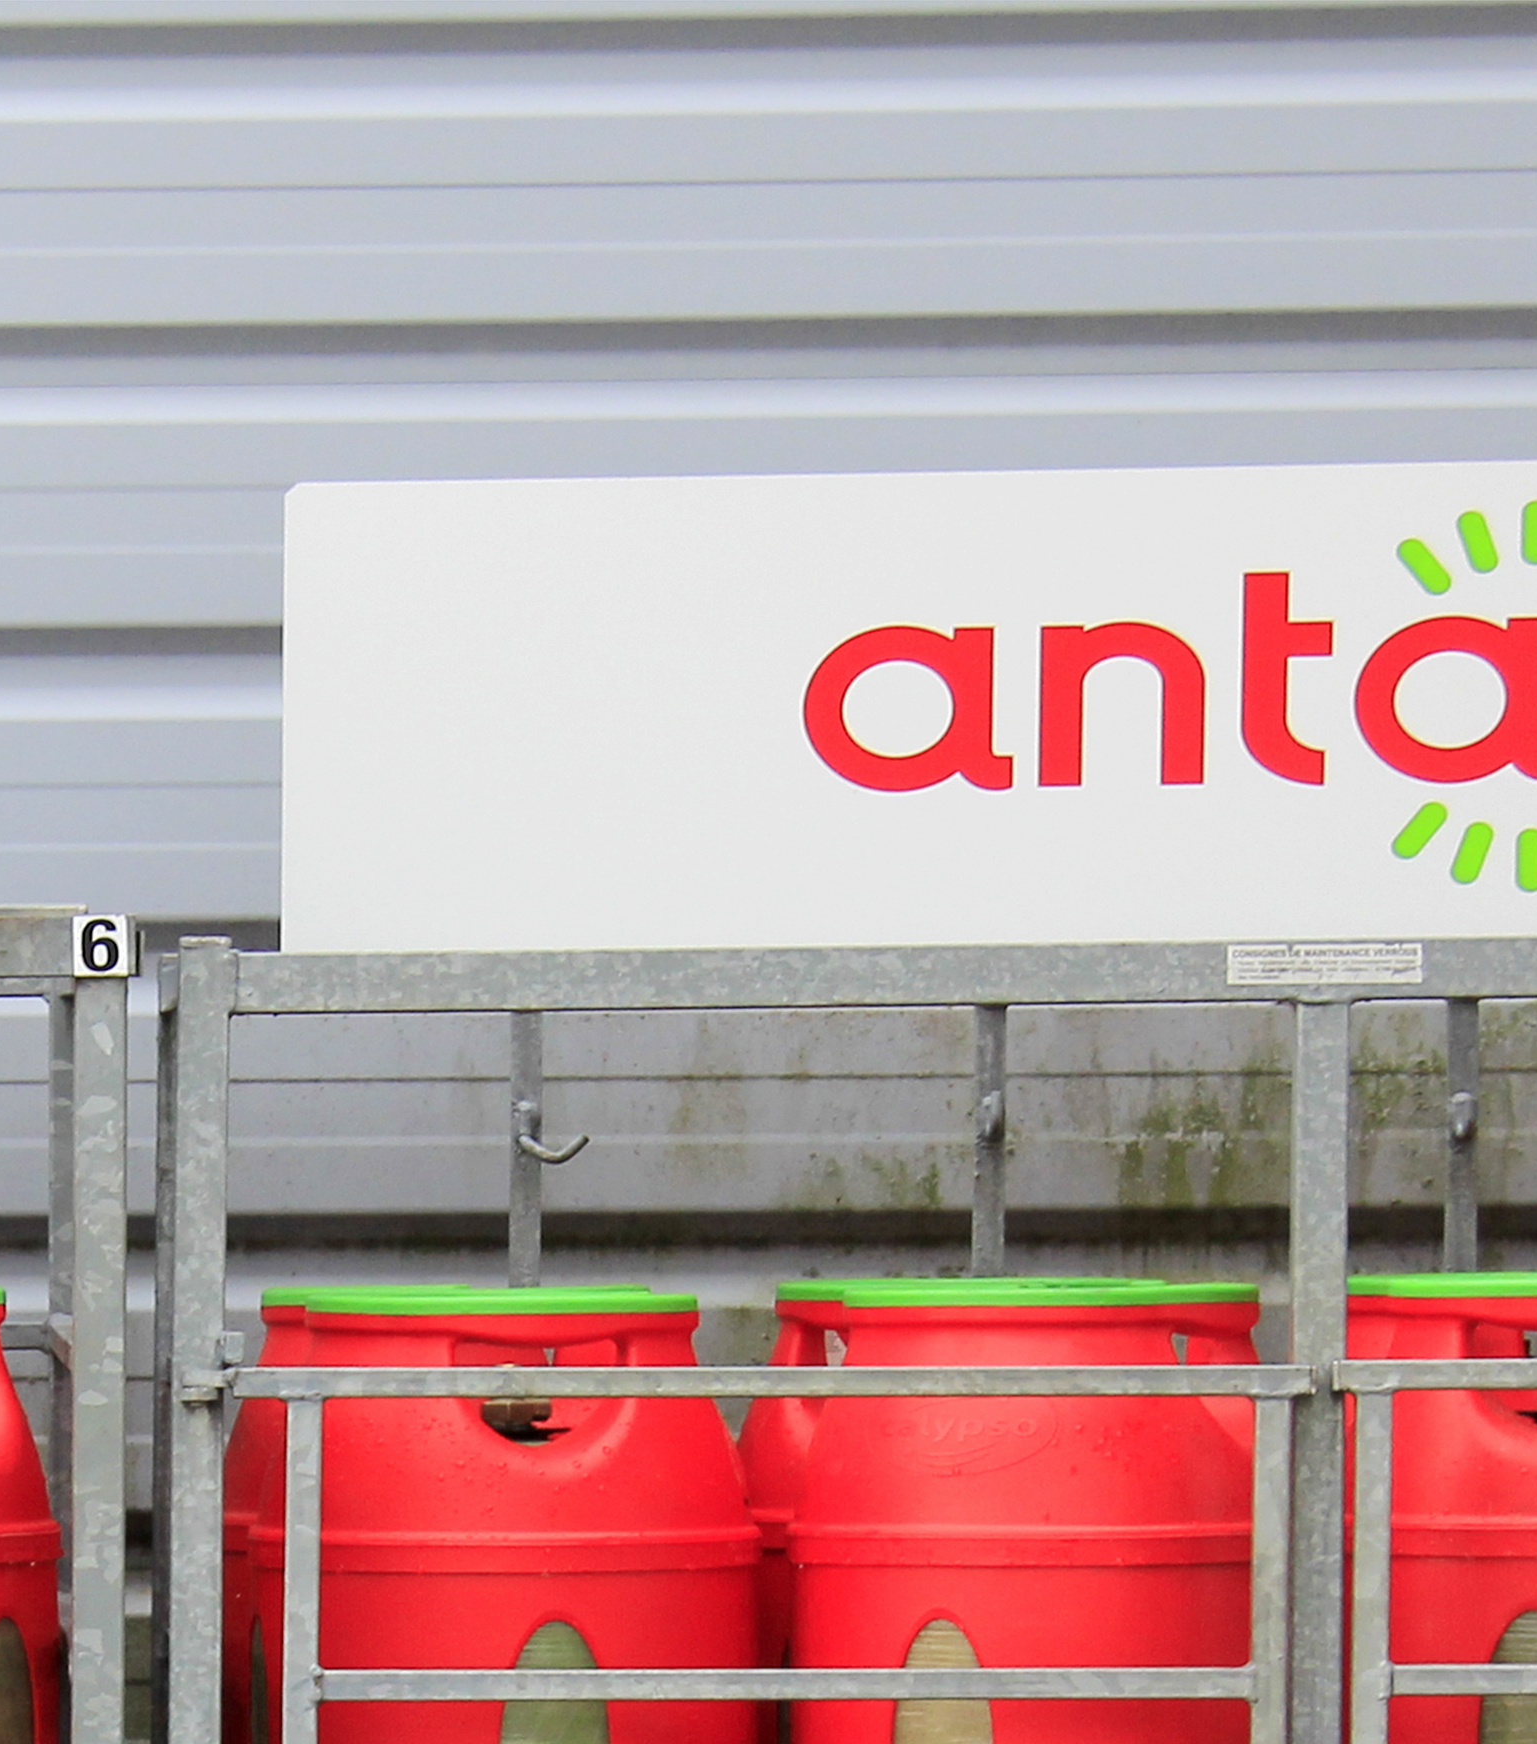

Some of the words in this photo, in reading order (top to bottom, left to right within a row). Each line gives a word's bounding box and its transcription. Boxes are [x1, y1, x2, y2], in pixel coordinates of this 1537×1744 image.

[81, 919, 120, 972] 6
[1304, 948, 1371, 957] MAINTENANCE
[879, 1411, 1038, 1443] calypso
